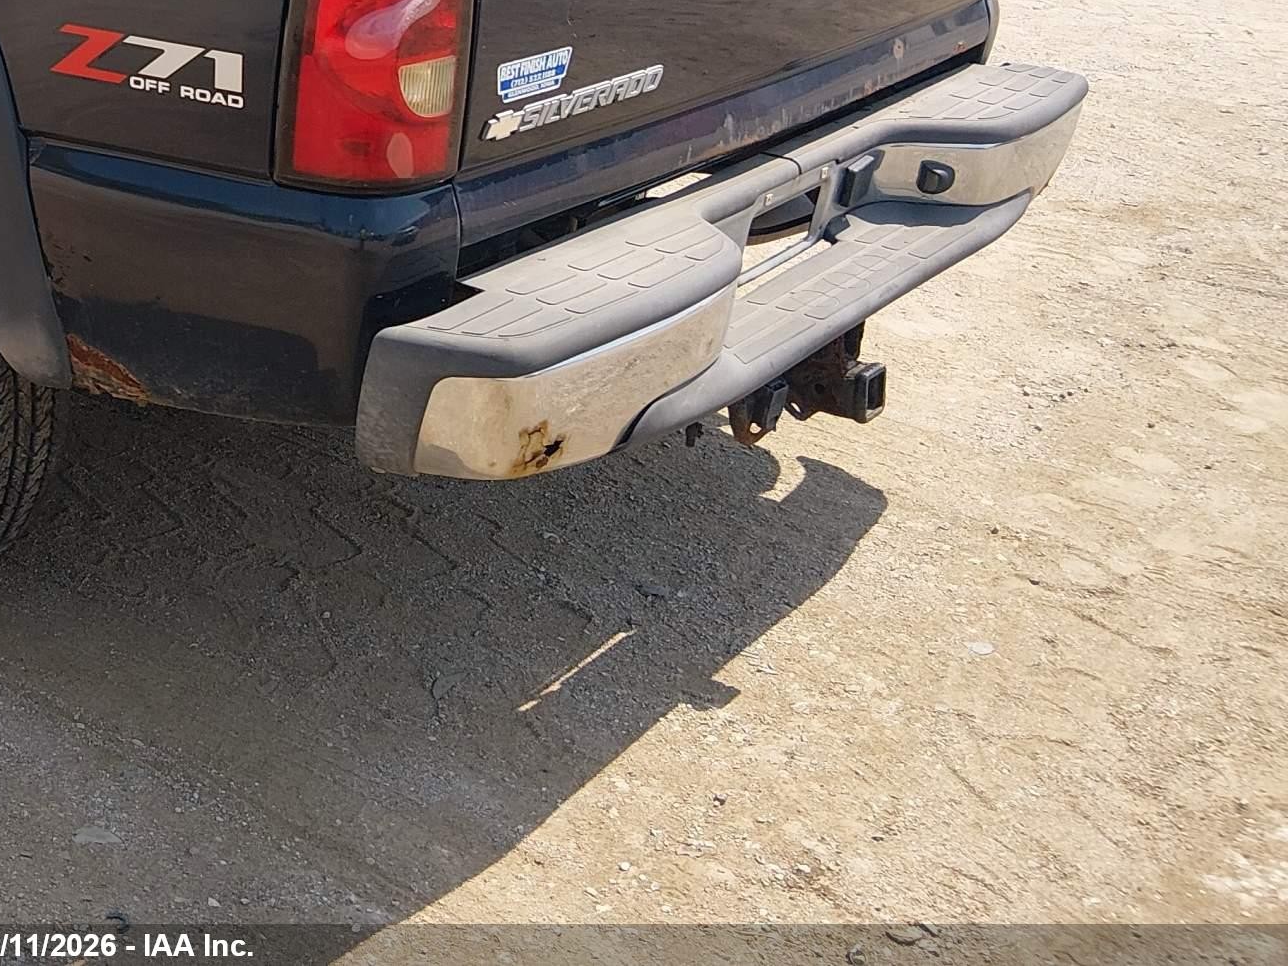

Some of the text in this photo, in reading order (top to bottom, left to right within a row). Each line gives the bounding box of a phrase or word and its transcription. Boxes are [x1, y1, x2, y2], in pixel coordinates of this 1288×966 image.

[49, 23, 245, 94] Z71
[500, 50, 569, 81] BEST FINISH AUTO
[129, 75, 244, 109] OFF ROAD
[510, 76, 528, 88] (712)
[518, 65, 664, 132] SILVERADO
